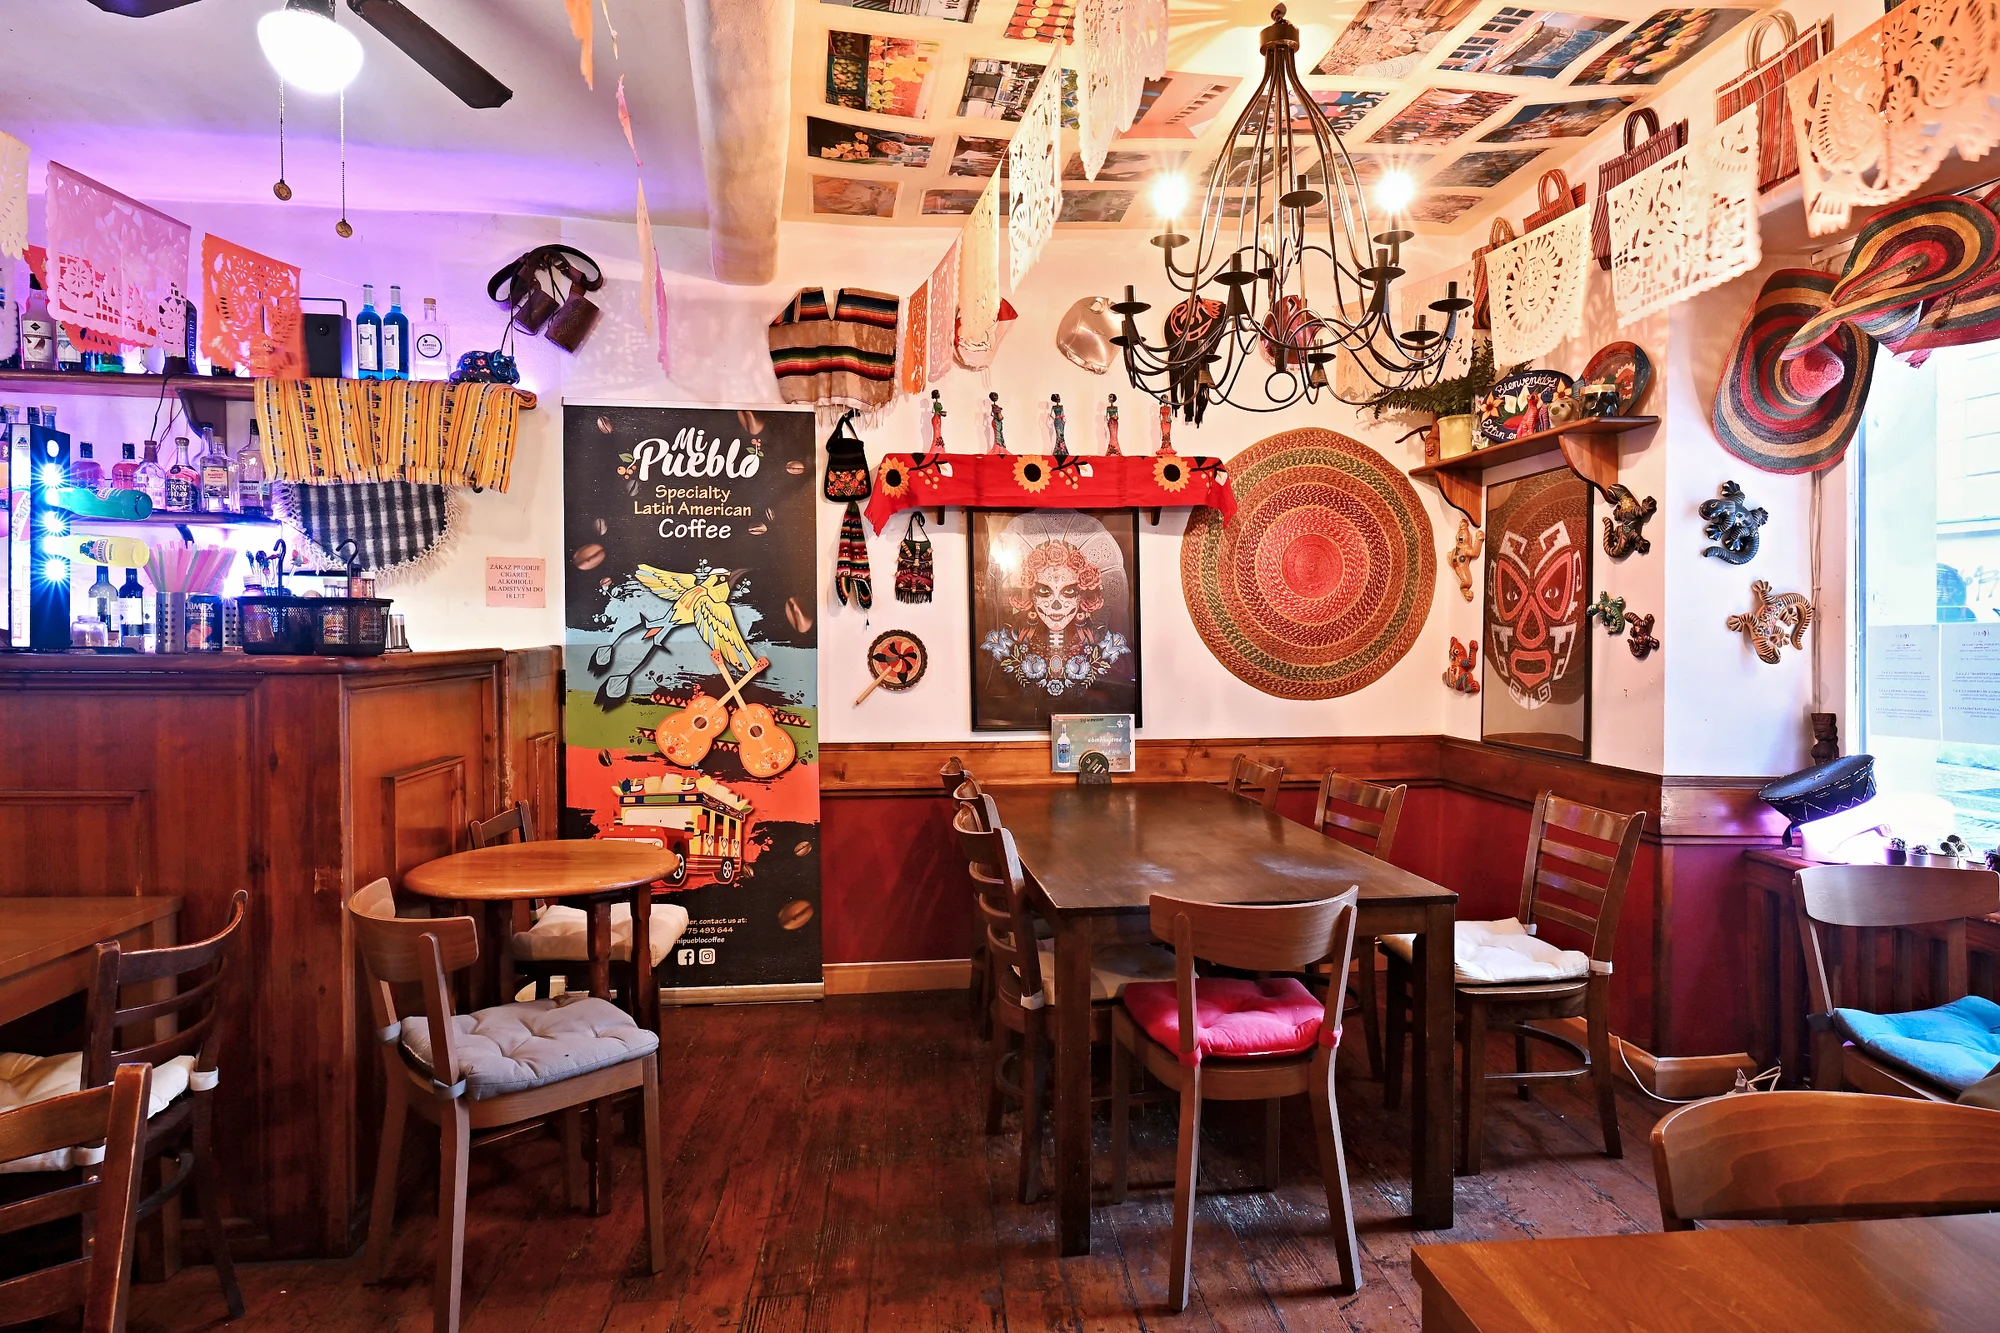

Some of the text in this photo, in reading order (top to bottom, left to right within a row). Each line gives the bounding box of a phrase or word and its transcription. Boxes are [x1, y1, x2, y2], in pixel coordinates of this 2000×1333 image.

[671, 427, 708, 452] Mi
[633, 438, 760, 481] Pueblo
[655, 484, 731, 502] Specialty
[634, 500, 752, 516] Latin American
[658, 518, 732, 539] Coffee
[699, 926, 716, 934] 493
[716, 926, 734, 934] 644
